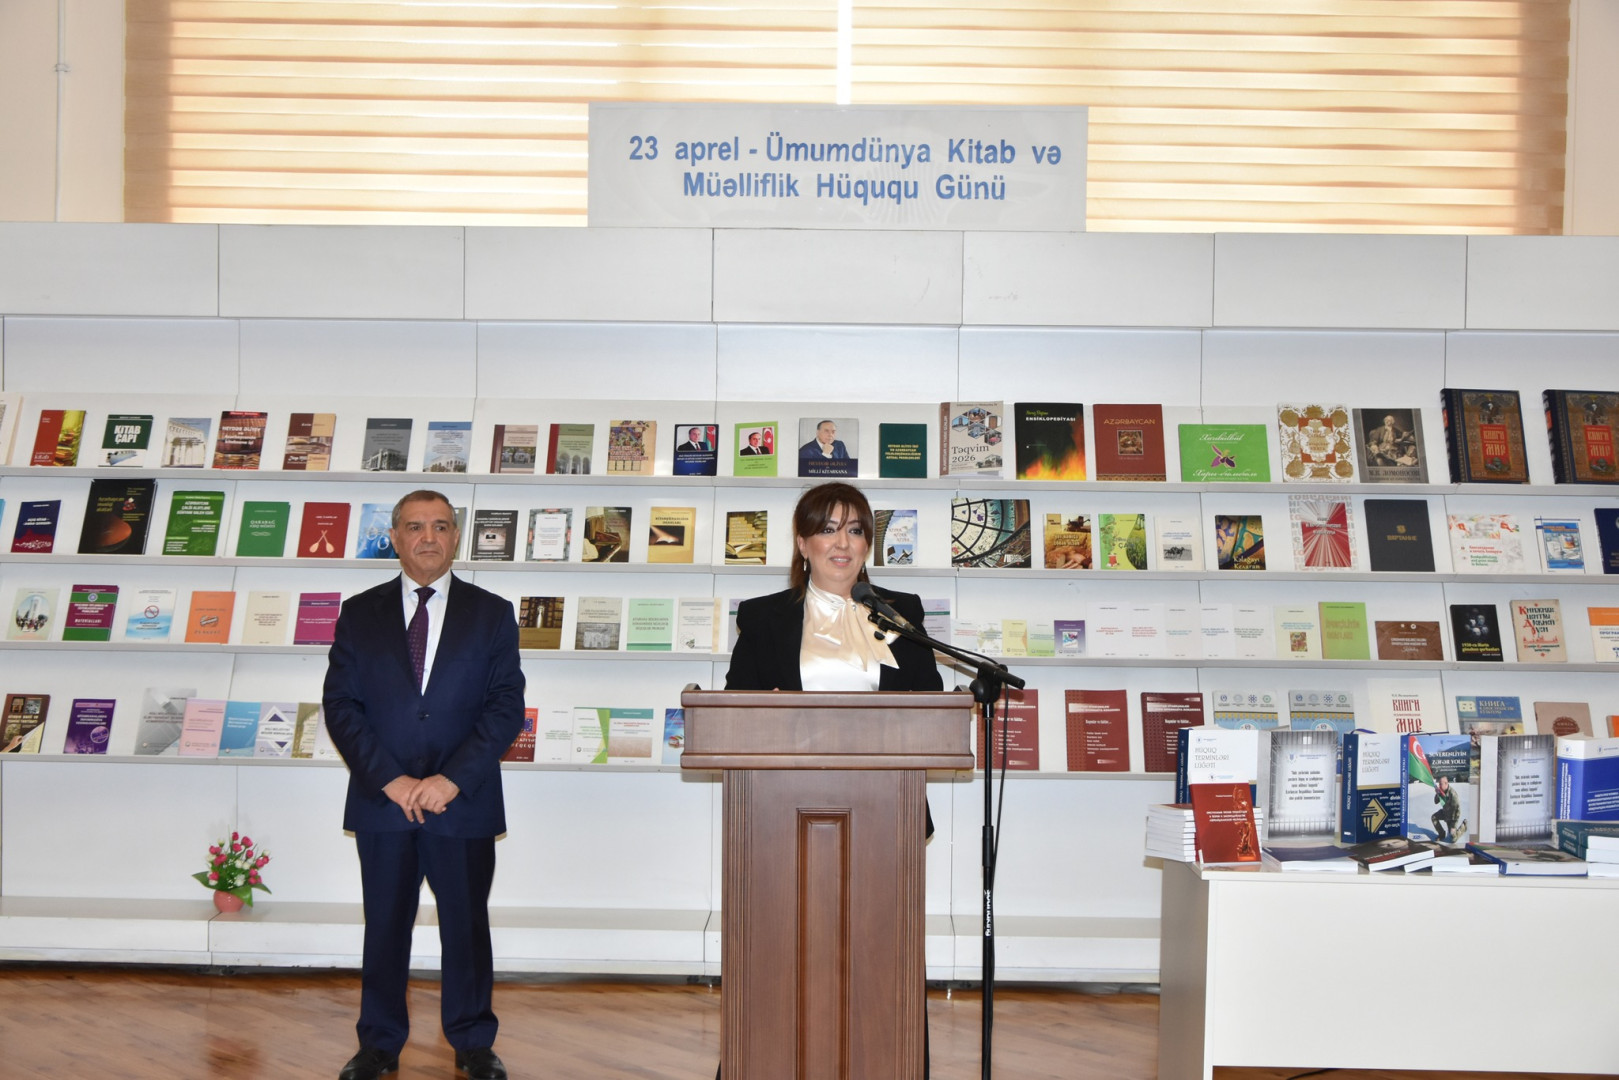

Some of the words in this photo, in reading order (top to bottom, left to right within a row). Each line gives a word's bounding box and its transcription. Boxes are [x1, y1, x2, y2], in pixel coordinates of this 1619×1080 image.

[630, 135, 658, 161] 23
[675, 136, 739, 166] aprel
[765, 132, 931, 169] Ümumdünya
[947, 138, 1016, 164] Kitab
[1032, 145, 1062, 165] və
[683, 171, 800, 198] Müəlliflik
[816, 172, 919, 206] Hüququ
[935, 174, 1006, 201] Günü
[115, 434, 137, 444] ÇAPI
[952, 444, 989, 454] Təqvim
[1392, 699, 1420, 712] КНИГИ
[1396, 718, 1422, 734] МИР
